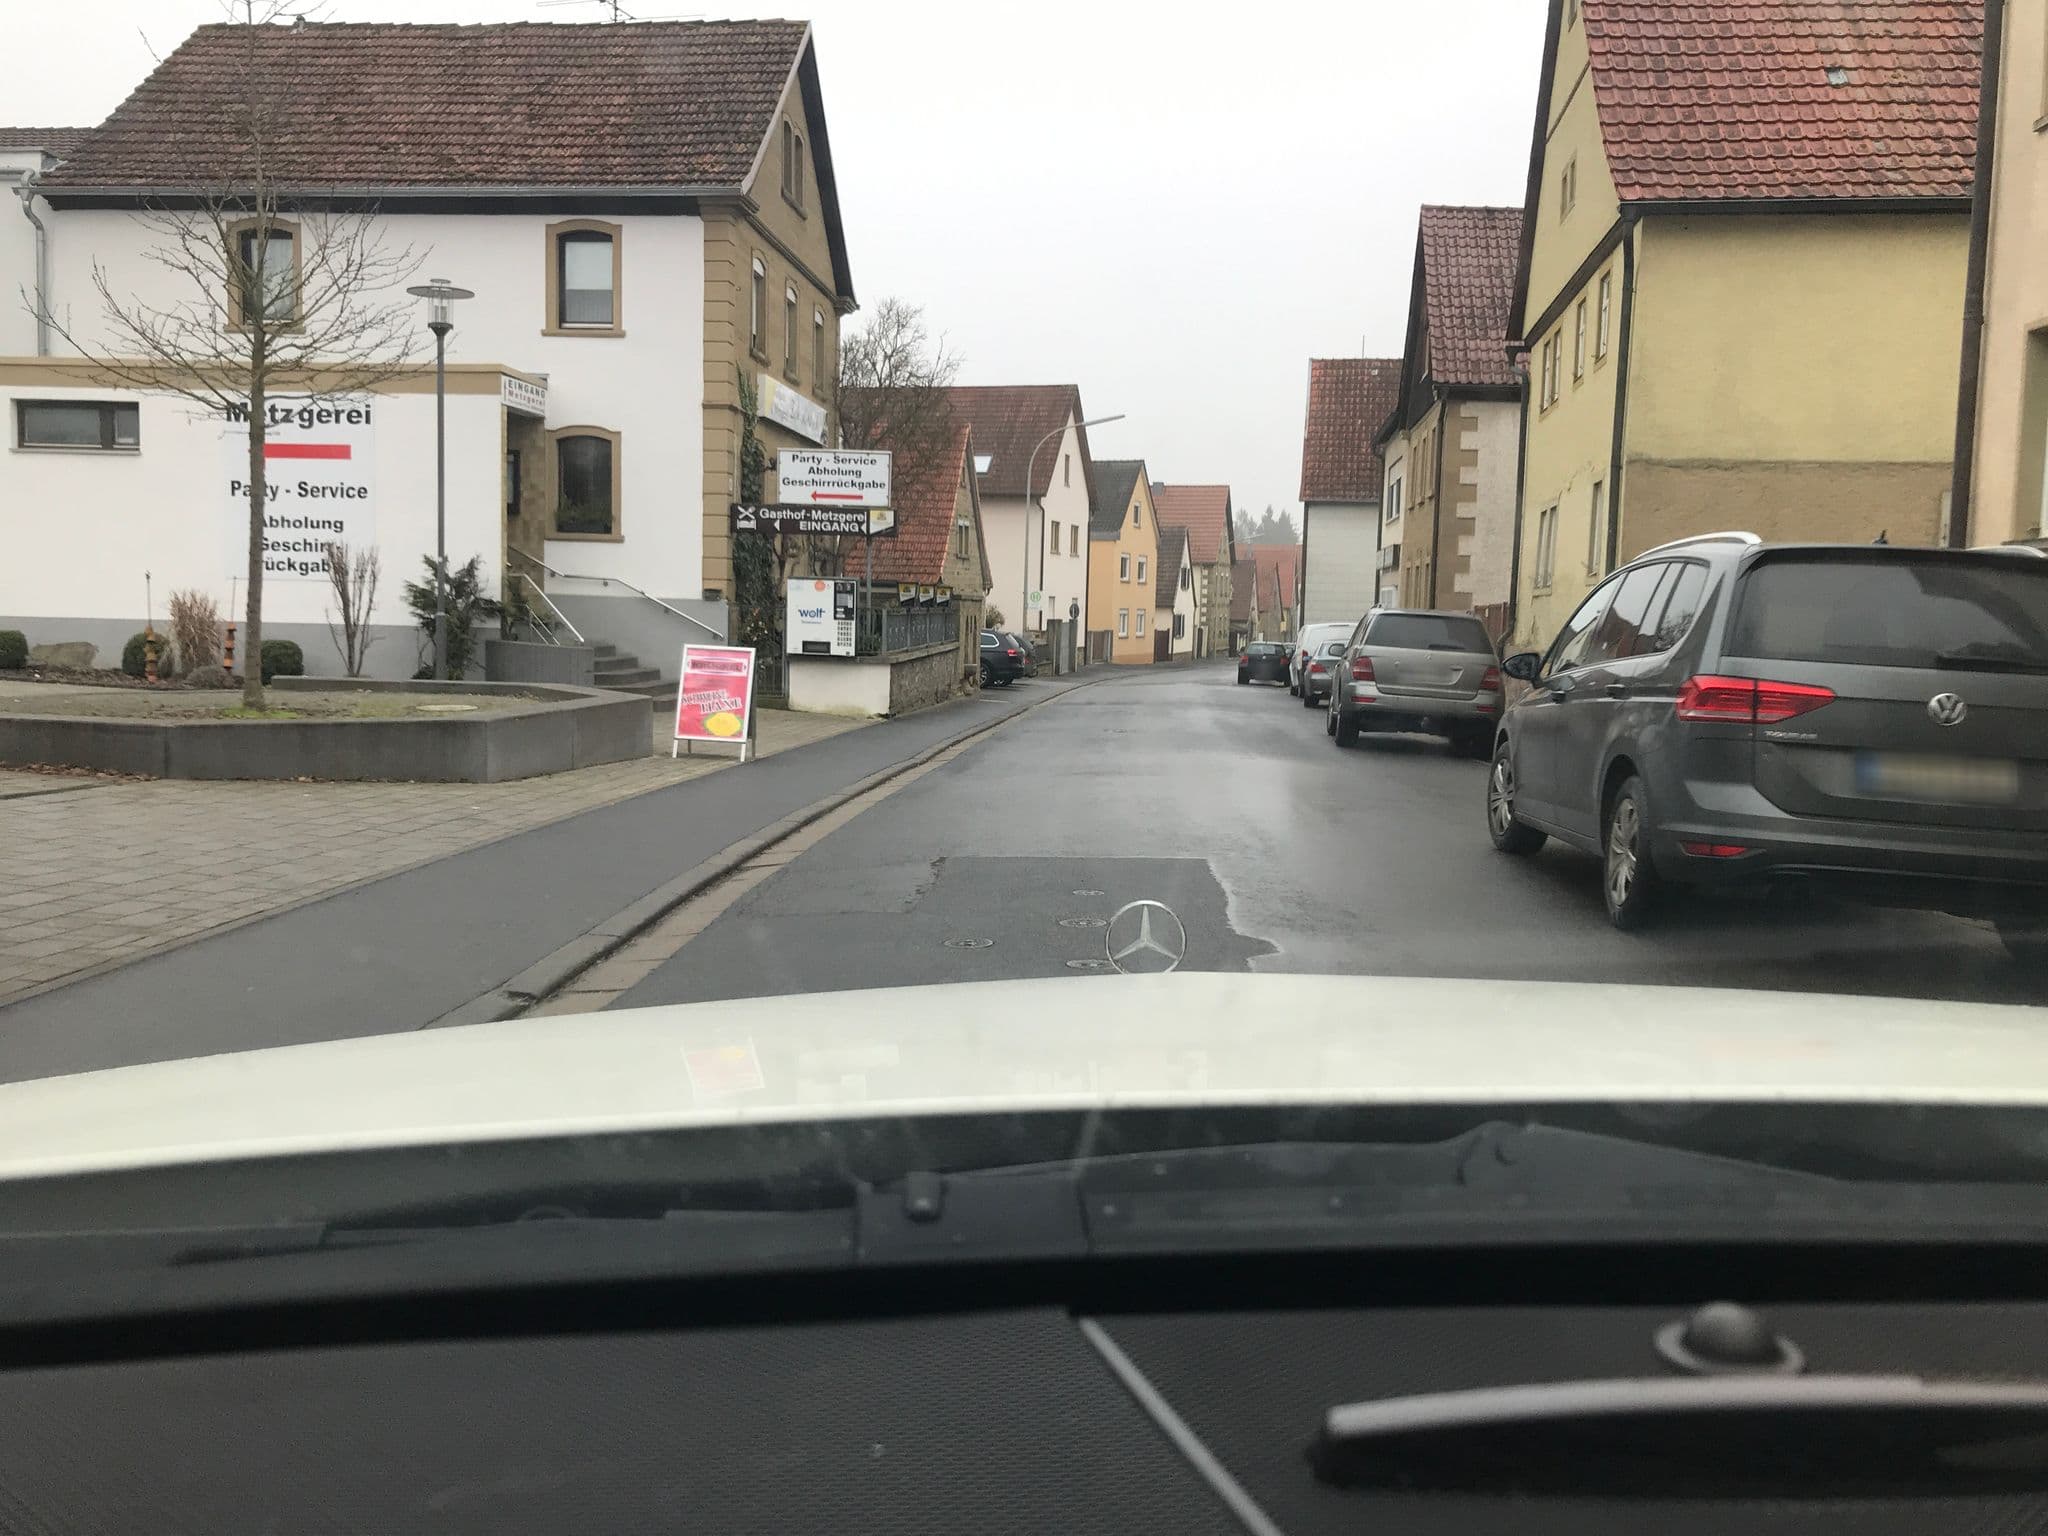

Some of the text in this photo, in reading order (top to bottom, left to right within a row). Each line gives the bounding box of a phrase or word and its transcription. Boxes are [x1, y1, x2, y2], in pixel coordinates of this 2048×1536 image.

[226, 402, 371, 429] Mtzgerei
[792, 454, 823, 464] Party
[833, 455, 877, 466] Service
[808, 466, 862, 478] Abholung
[230, 480, 279, 501] Paty
[297, 481, 368, 499] Service
[800, 522, 859, 532] EINGANG
